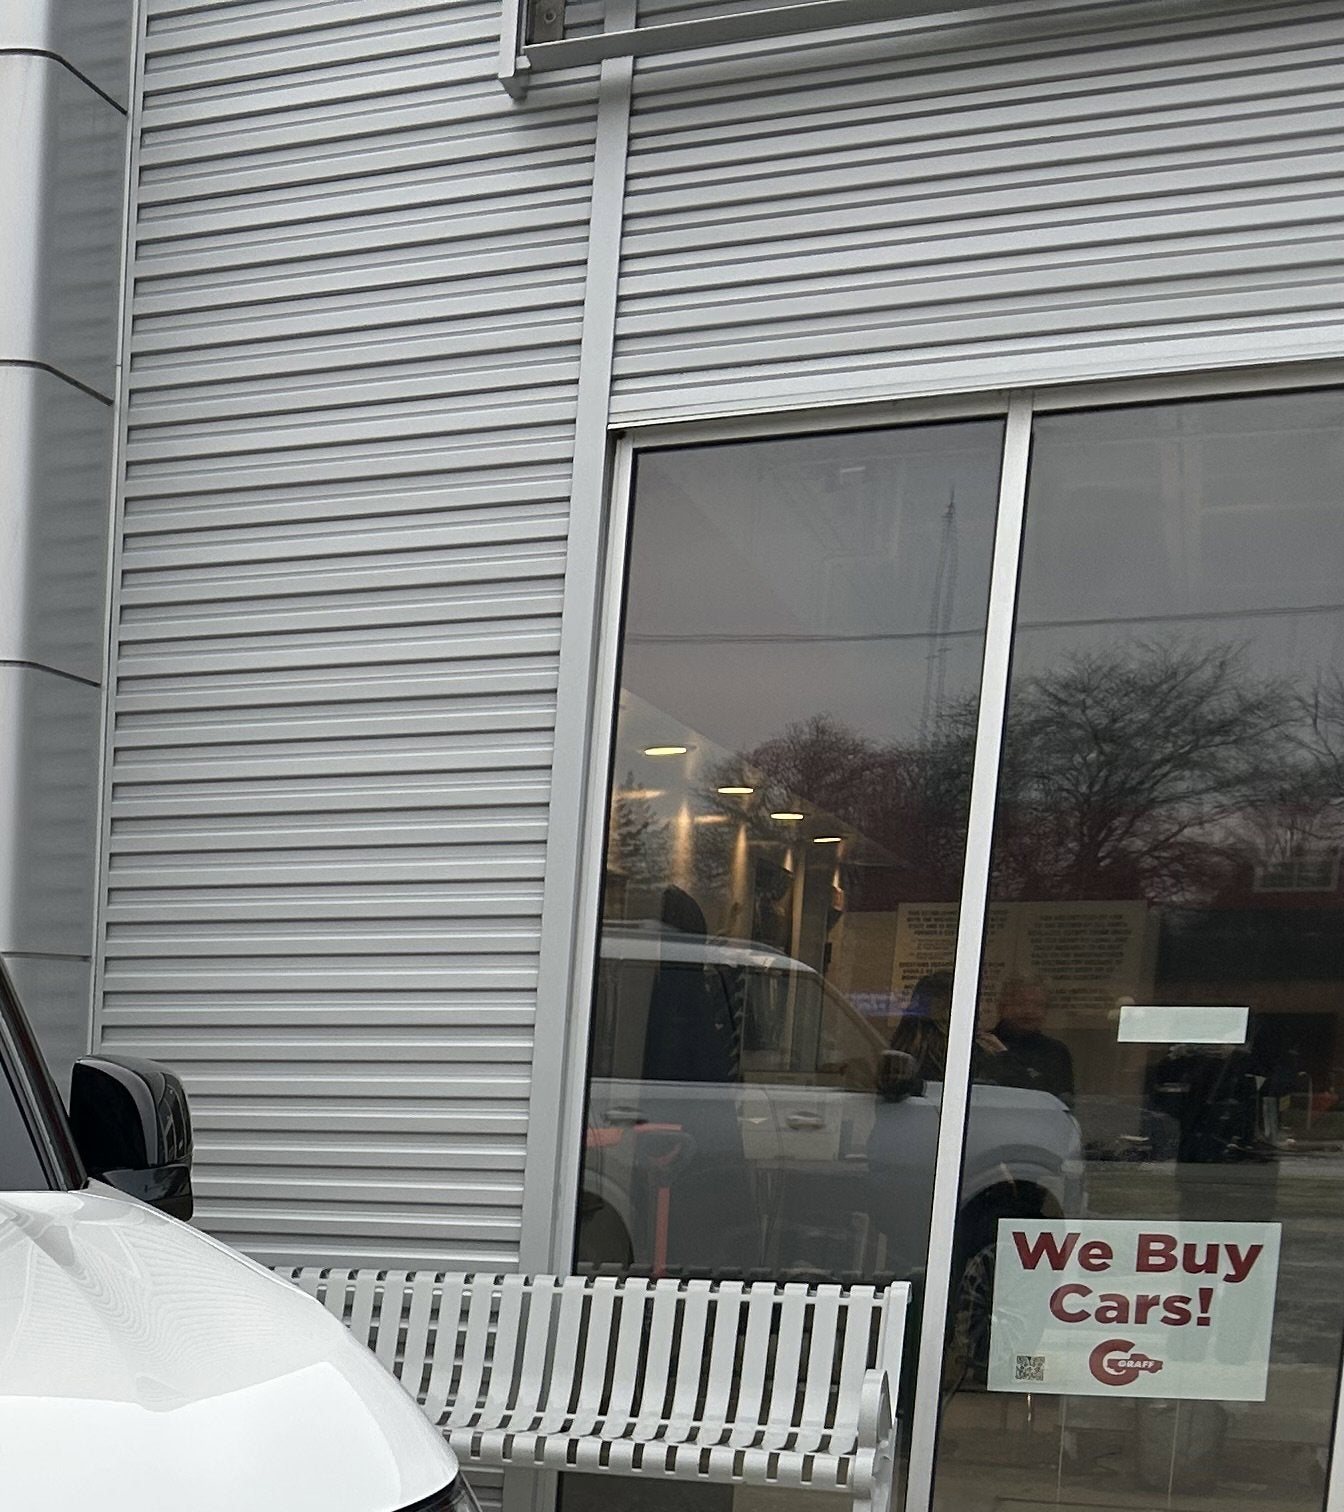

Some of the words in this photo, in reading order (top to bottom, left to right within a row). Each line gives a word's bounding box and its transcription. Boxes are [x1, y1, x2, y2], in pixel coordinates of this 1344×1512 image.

[1012, 1231, 1114, 1273] We
[1135, 1233, 1264, 1283] Buy
[1049, 1283, 1214, 1327] Cars!
[1117, 1360, 1155, 1369] GRAFF
